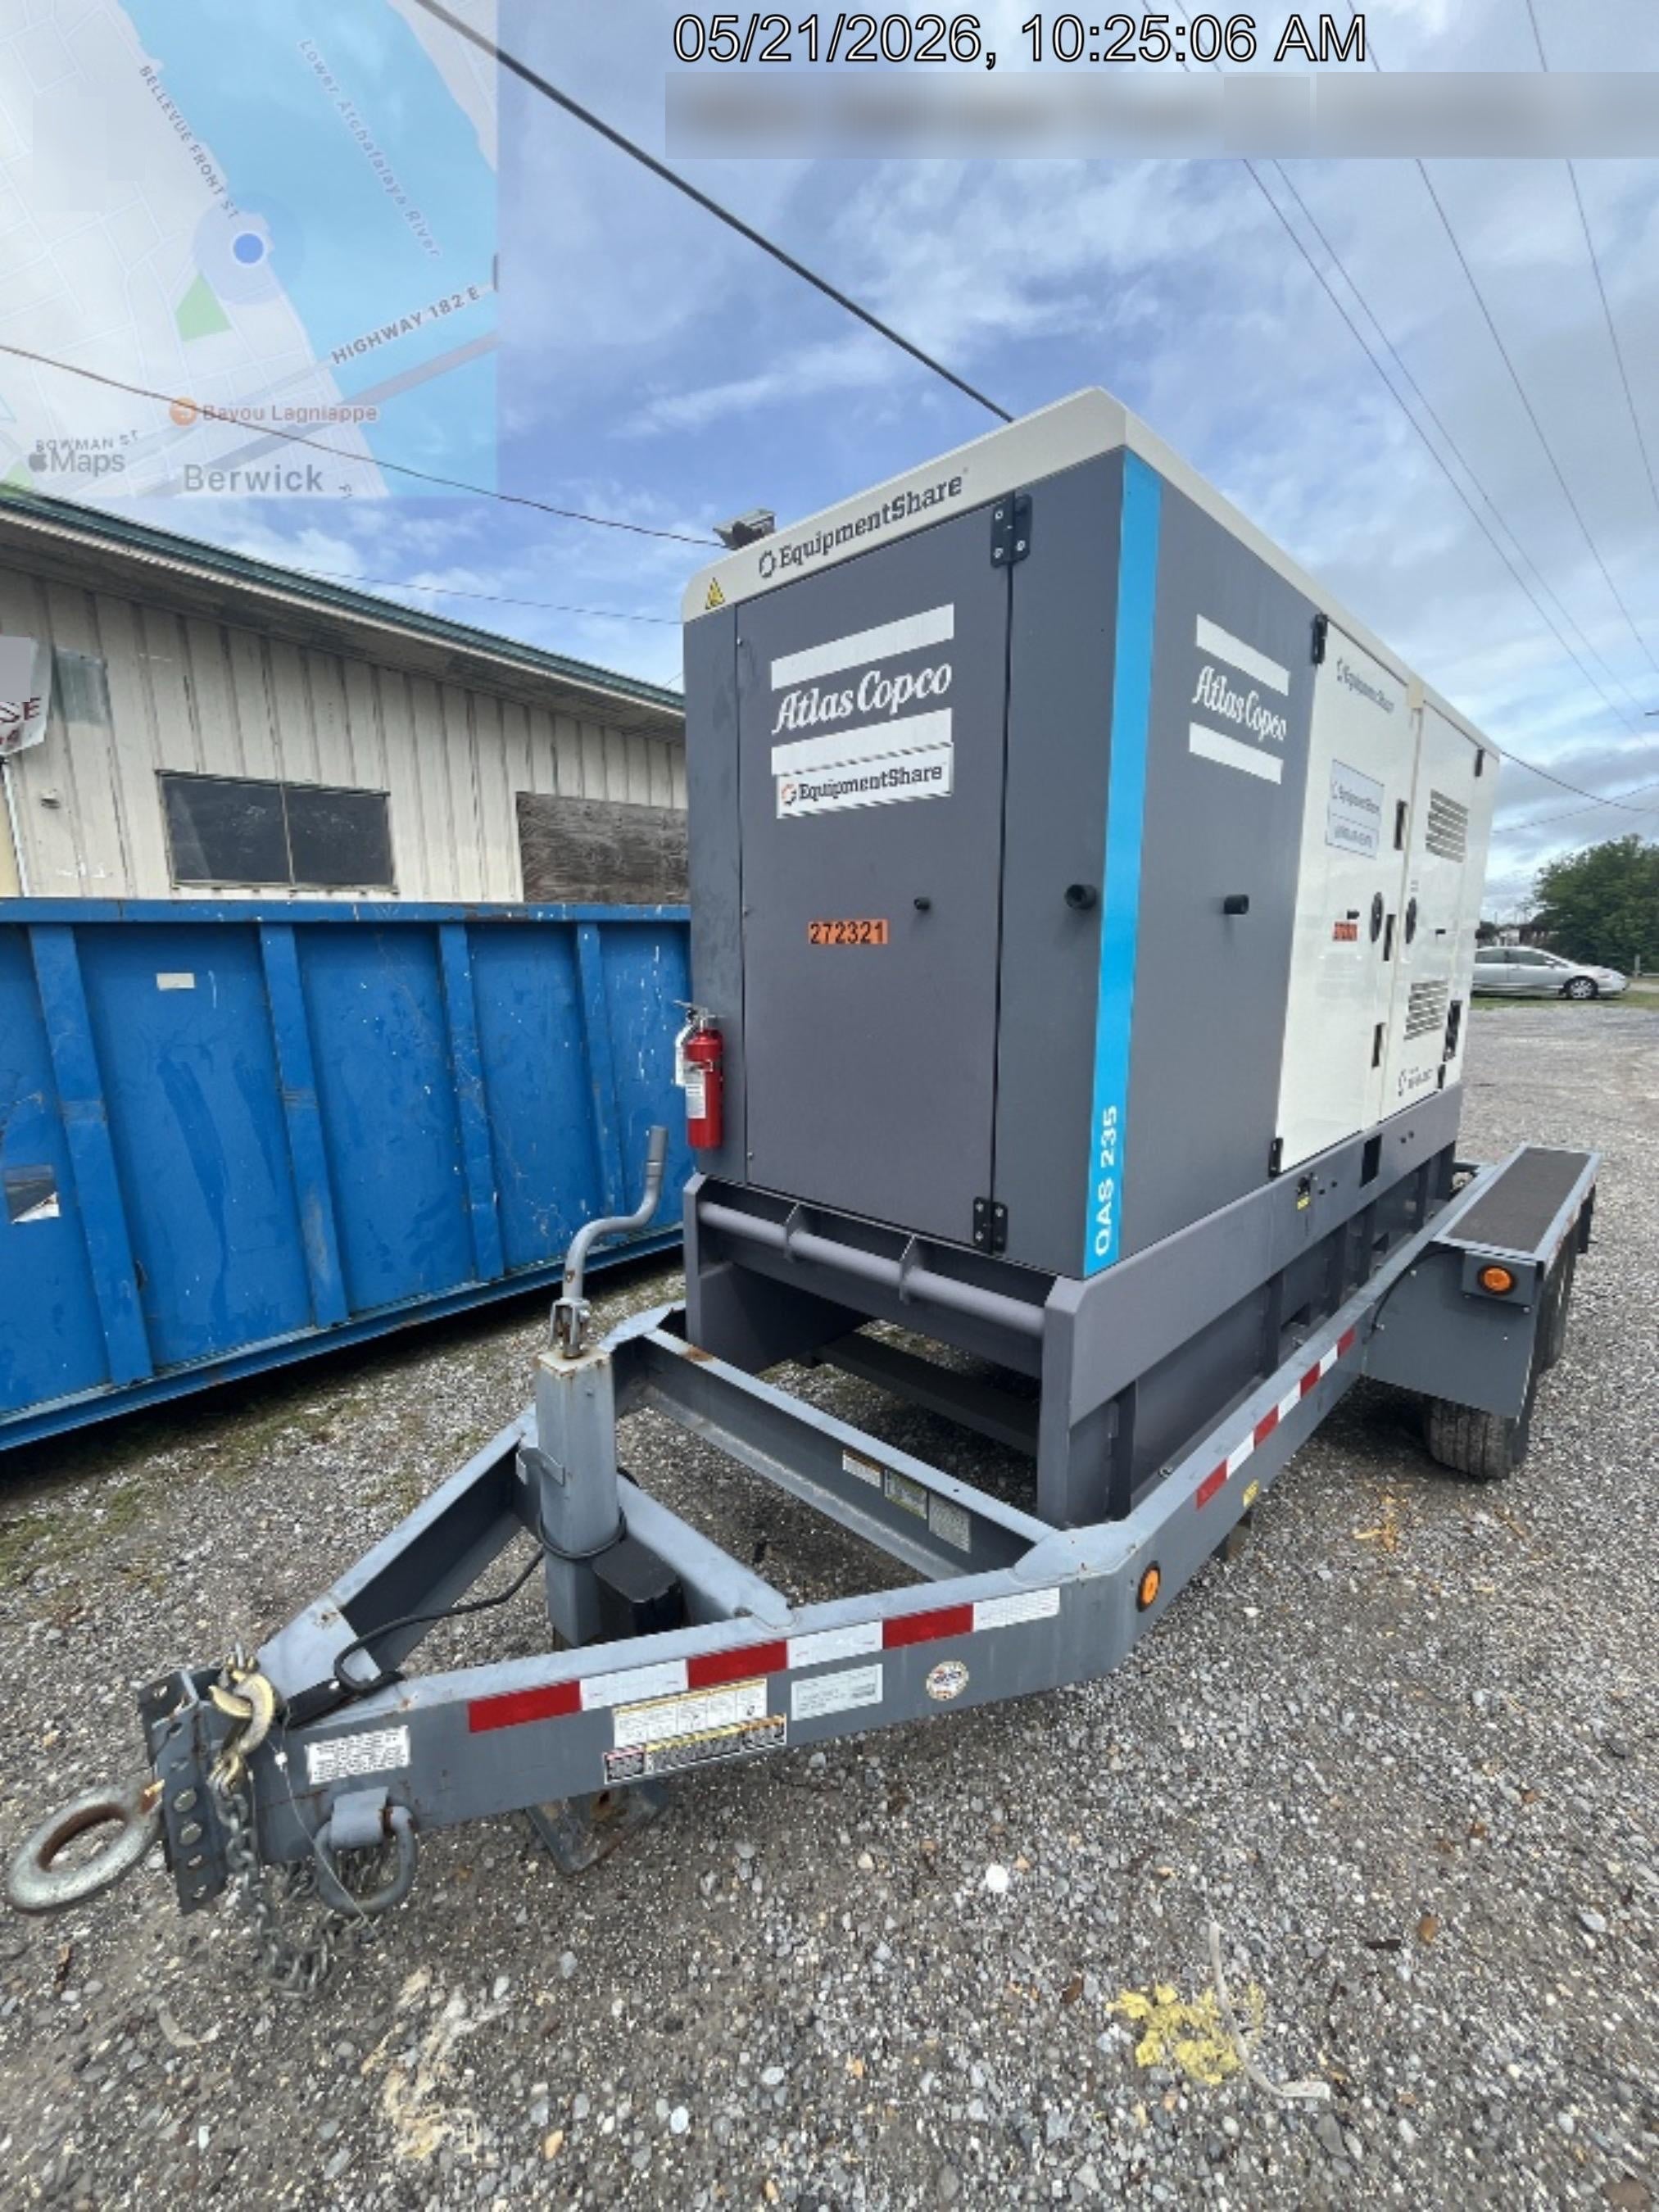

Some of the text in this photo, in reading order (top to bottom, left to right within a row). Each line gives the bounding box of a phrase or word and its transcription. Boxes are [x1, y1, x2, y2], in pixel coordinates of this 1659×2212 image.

[779, 475, 963, 569] EquipmentShare
[771, 663, 953, 736] Atlas Copco
[1191, 665, 1287, 742] Atlas Copco
[798, 765, 943, 802] EquipmentShare
[809, 920, 884, 945] 272321
[1099, 1104, 1117, 1169] 235
